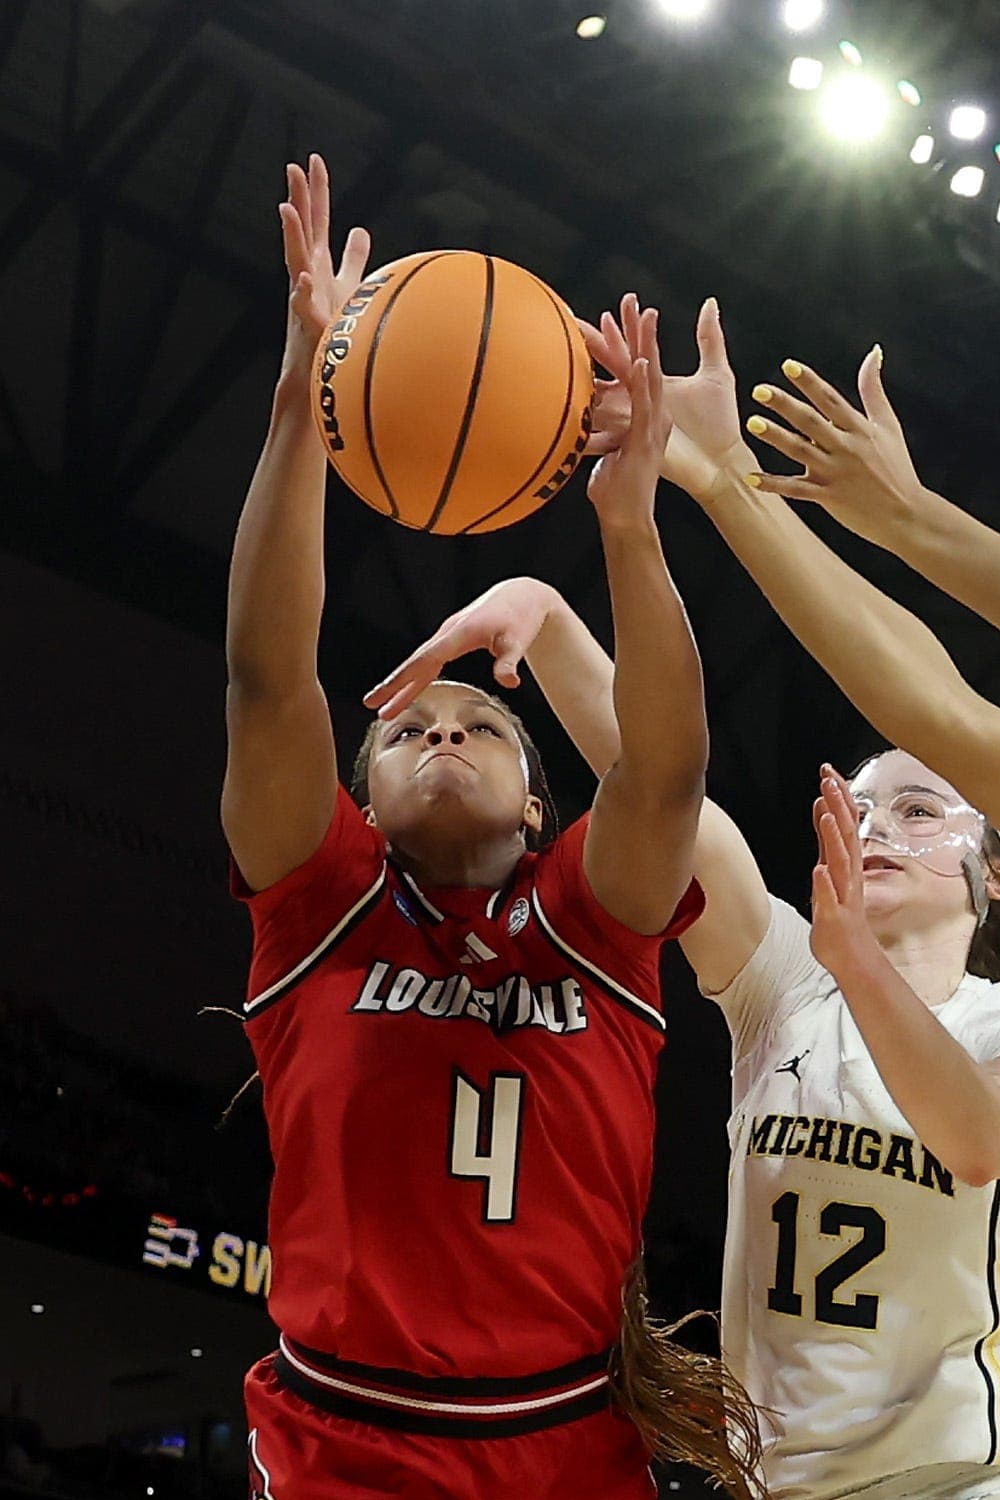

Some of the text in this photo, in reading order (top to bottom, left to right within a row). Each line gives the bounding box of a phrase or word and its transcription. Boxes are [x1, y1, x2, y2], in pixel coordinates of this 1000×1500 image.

[349, 960, 589, 1034] LOUISVILLE
[450, 1074, 523, 1222] 4
[746, 1114, 957, 1198] MICHIGAN
[766, 1190, 887, 1331] 12
